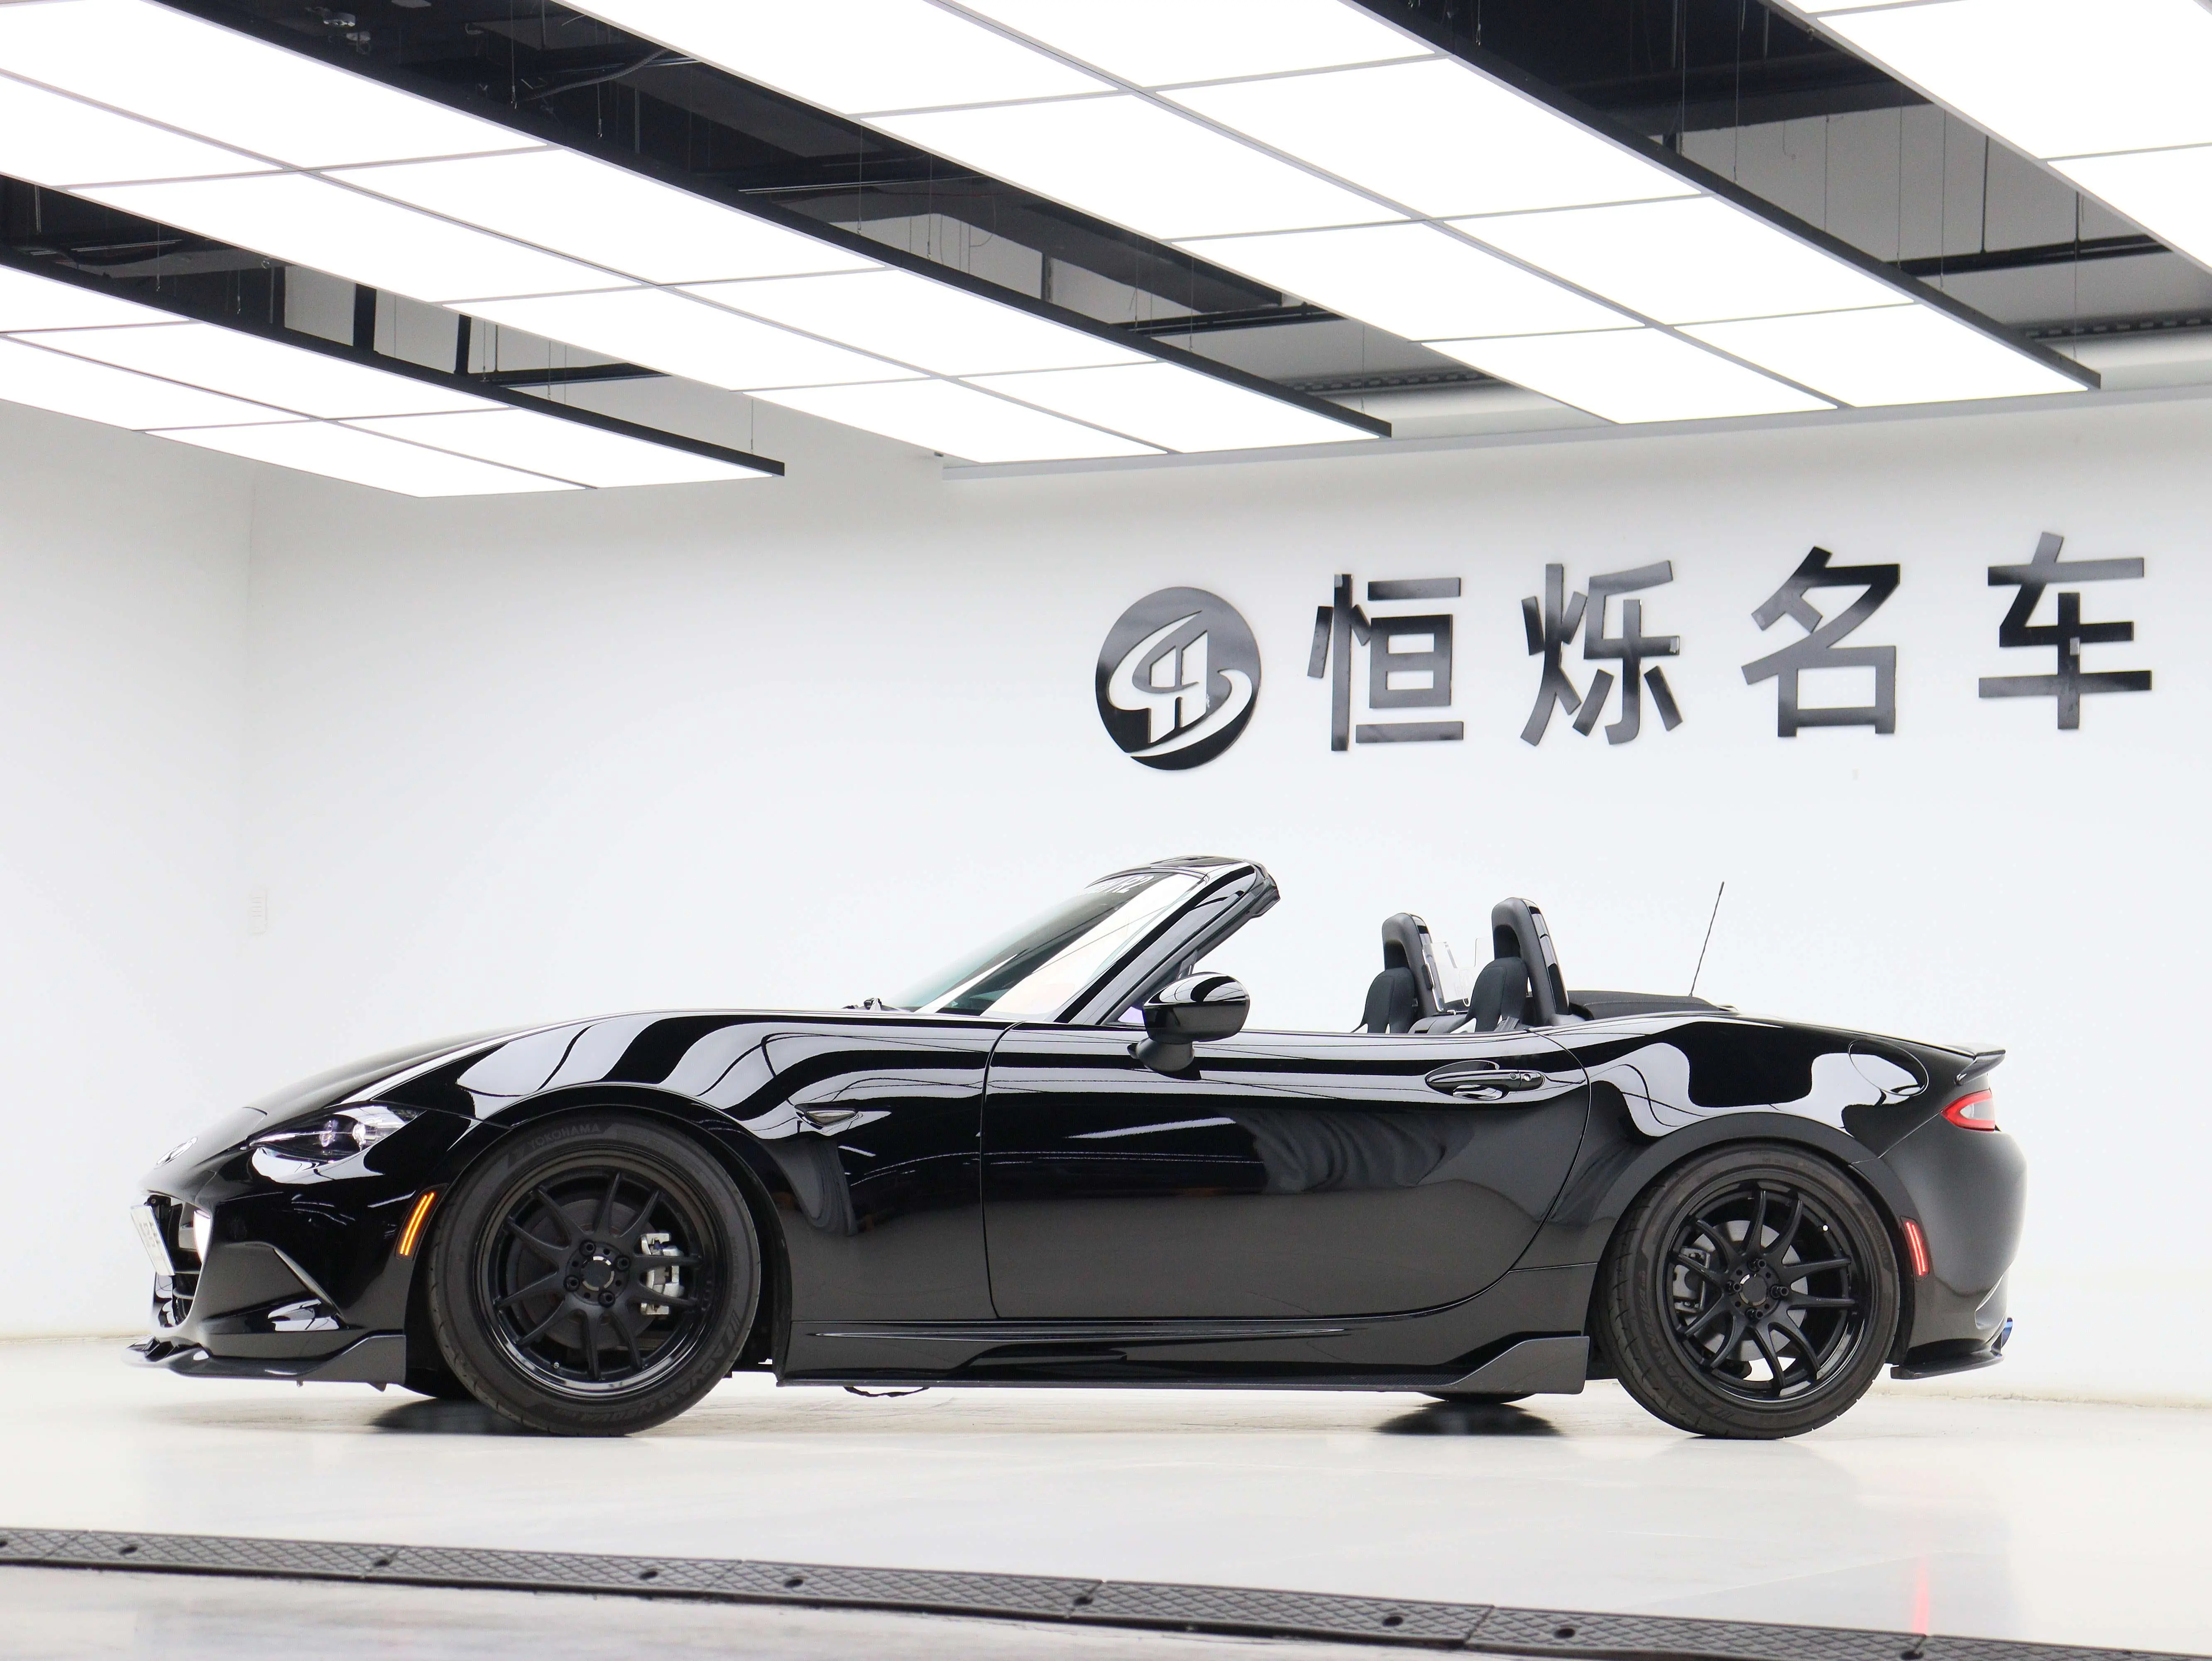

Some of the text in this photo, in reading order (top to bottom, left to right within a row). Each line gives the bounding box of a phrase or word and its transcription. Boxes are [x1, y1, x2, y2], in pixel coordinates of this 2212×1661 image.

[1307, 532, 2152, 752] 恒烁名车
[526, 1123, 601, 1149] YOKOHAMA
